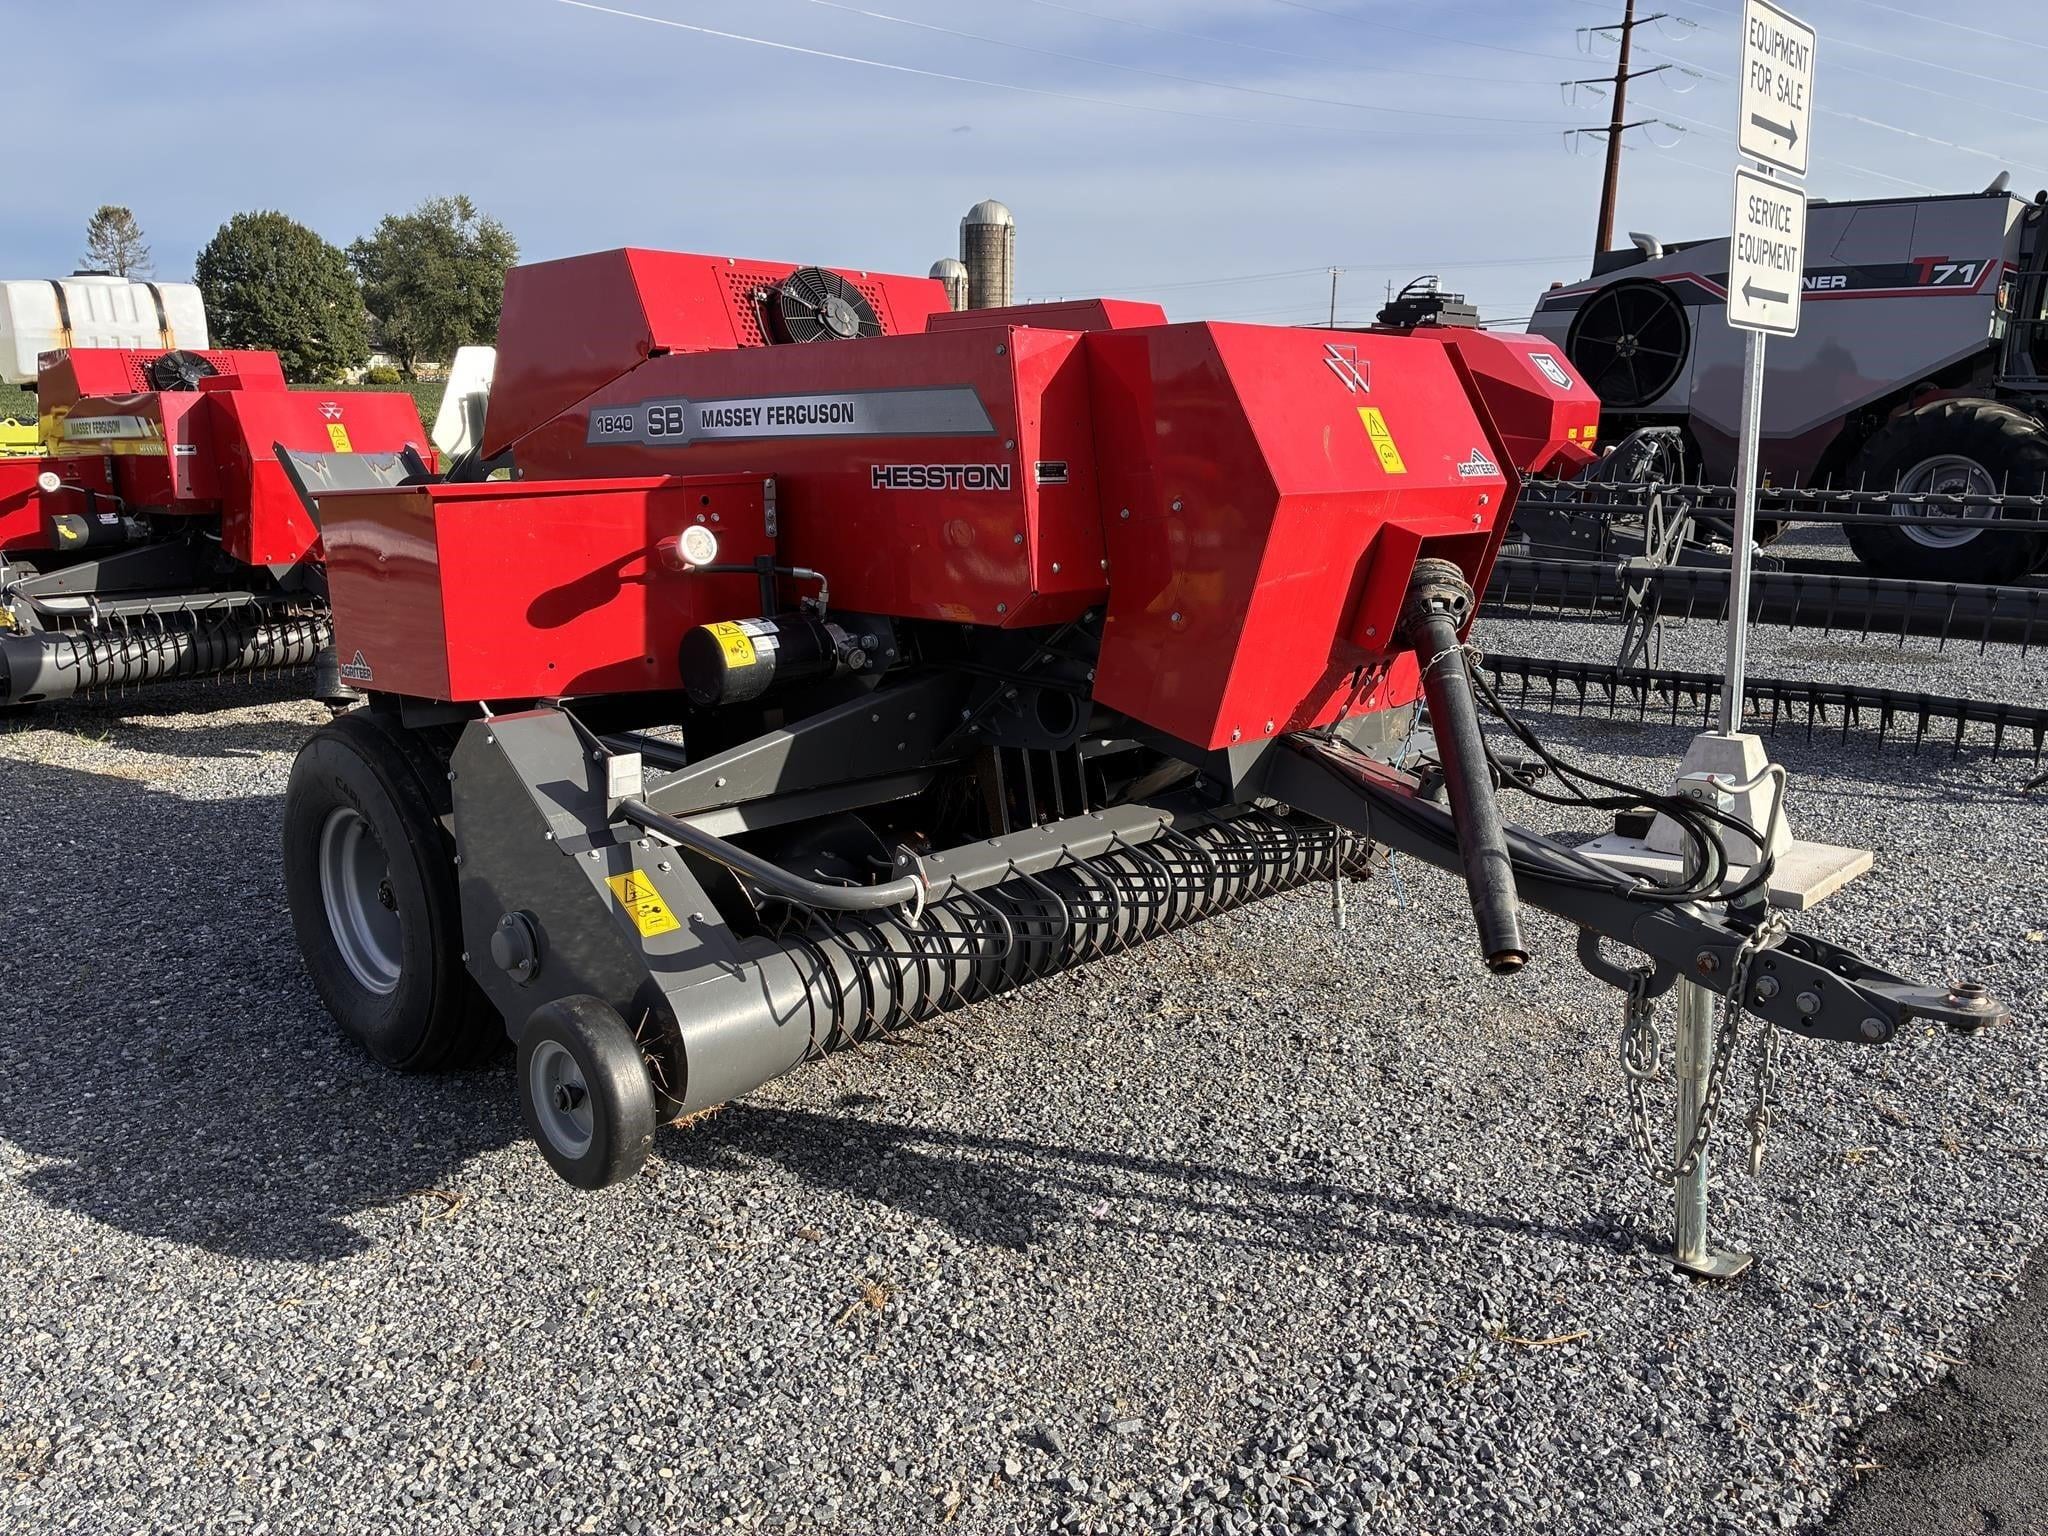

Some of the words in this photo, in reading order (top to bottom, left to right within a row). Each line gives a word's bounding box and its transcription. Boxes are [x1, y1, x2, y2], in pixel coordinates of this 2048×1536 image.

[1750, 17, 1809, 74] EQUIPMENT
[1751, 60, 1772, 96] FOR
[1777, 73, 1803, 111] SALE
[1748, 194, 1792, 233] SERVICE
[1738, 233, 1797, 272] EQUIPMENT
[1913, 256, 1976, 285] T71
[71, 422, 92, 435] MASSEY
[92, 419, 121, 434] FERGUSON
[597, 414, 633, 434] 1840
[648, 405, 683, 436] SB
[701, 407, 762, 428] MASSEY
[767, 401, 855, 425] FERGUSON
[871, 464, 1011, 490] HESSTON
[1458, 463, 1498, 475] AGRITEER
[341, 664, 372, 680] AGRITEER
